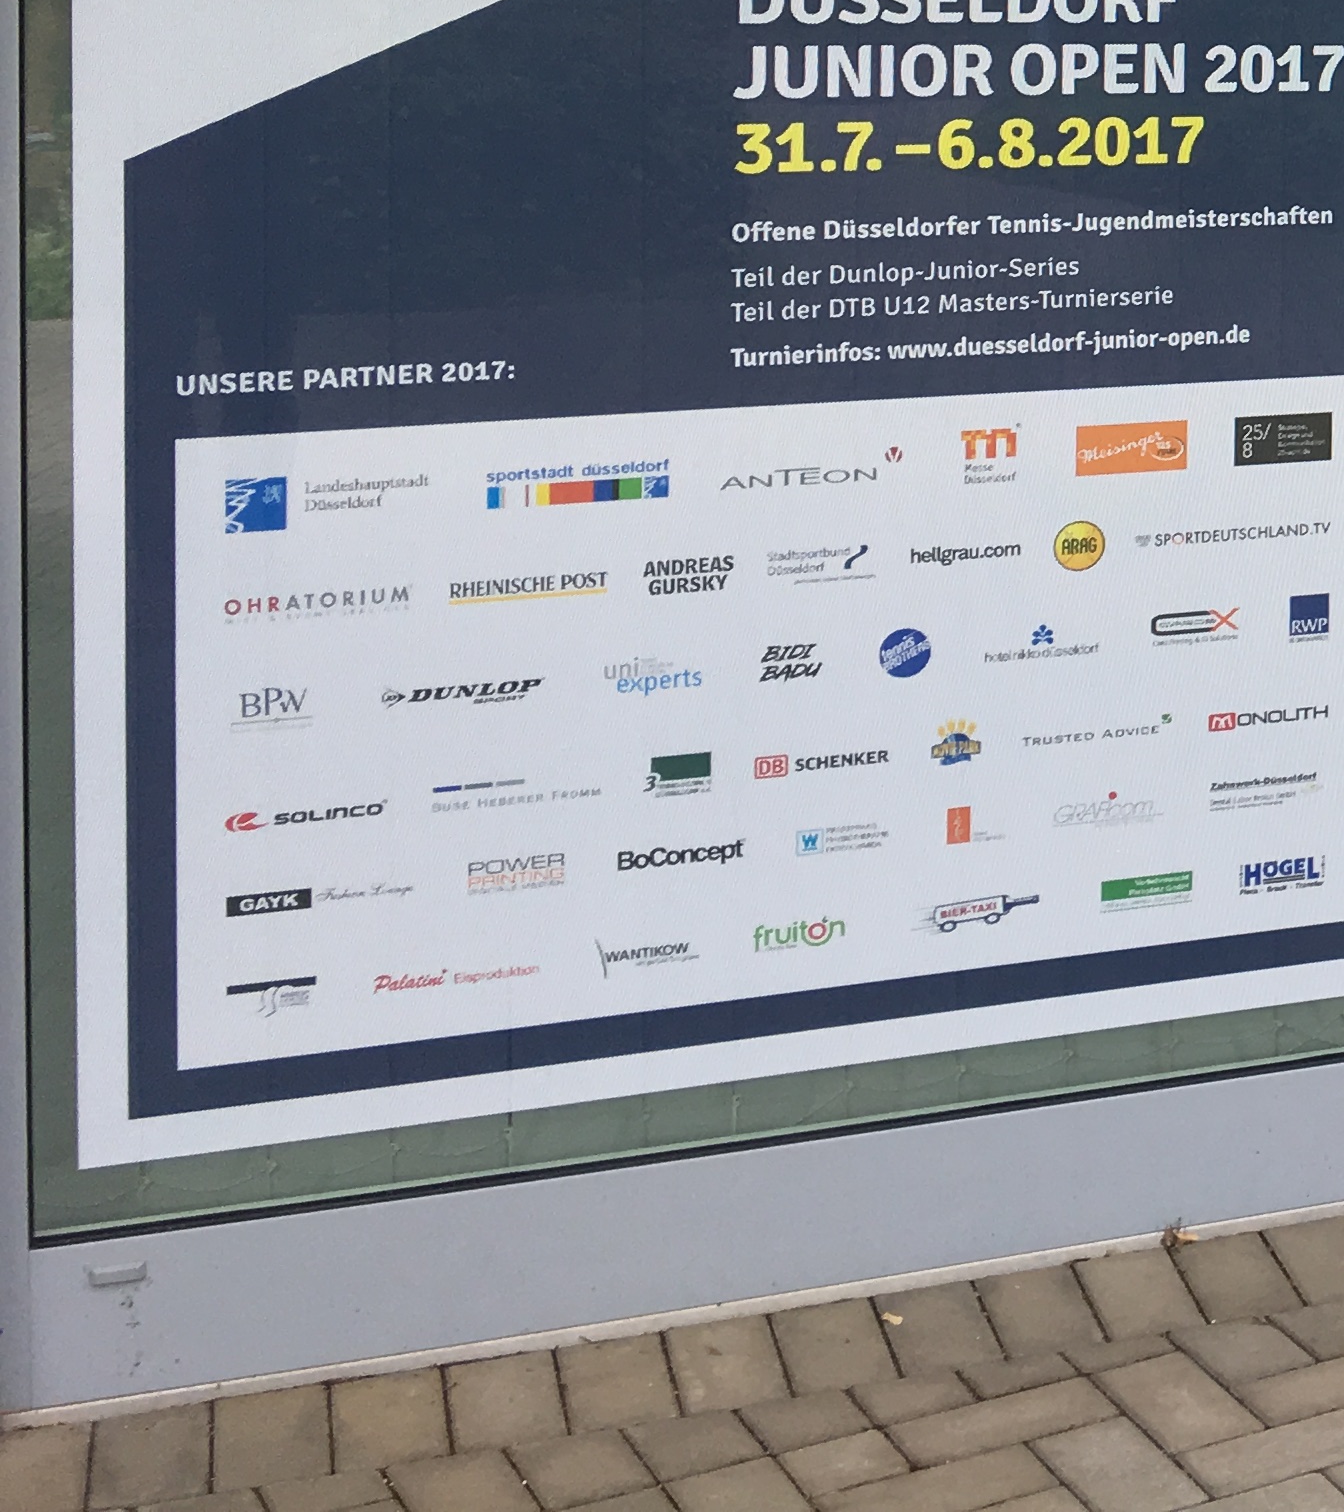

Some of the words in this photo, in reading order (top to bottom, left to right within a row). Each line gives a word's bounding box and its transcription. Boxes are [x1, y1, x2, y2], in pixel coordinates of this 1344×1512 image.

[733, 44, 994, 100] JUNIOR
[1010, 42, 1186, 96] OPEN
[731, 219, 816, 245] Offene
[823, 210, 981, 241] Düsseldorfer
[987, 204, 1334, 240] Tennis-Jugendmeisterschaften
[731, 265, 776, 289] Teil
[781, 263, 822, 287] der
[828, 257, 1080, 290] Dunlop-Junior-Series
[731, 299, 776, 324] Teil
[781, 297, 822, 322] der
[828, 295, 877, 320] DTB
[883, 293, 930, 318] U12
[938, 286, 1174, 315] Masters-Turnierserie
[730, 341, 881, 369] Turnierinfos:
[887, 325, 1251, 361] www.duesseldorf-junior-open.de
[176, 369, 294, 397] UNSERE
[303, 362, 434, 390] PARTNER
[441, 360, 516, 383] 2017:
[1241, 422, 1272, 441] 25/
[1077, 431, 1164, 465] Meisinger
[1242, 441, 1254, 459] 8
[486, 464, 574, 484] sportstadt
[581, 458, 670, 478] düsseldorf
[720, 467, 878, 491] ANTEON
[304, 474, 430, 495] Landeshauptstadt
[304, 493, 383, 513] Düsseldorf
[1061, 536, 1097, 556] ARAG
[1155, 522, 1331, 548] SPORTDEUTSCHLAND.TV
[910, 542, 1021, 566] hellgrau.com
[643, 555, 734, 579] ANDREAS
[449, 576, 556, 600] RHEINISCHE
[560, 571, 608, 590] POST
[648, 574, 728, 596] GURSKY
[223, 586, 410, 616] OHRATORIUM
[1291, 617, 1328, 634] RWP
[760, 643, 817, 663] BIDI
[616, 667, 703, 696] experts
[759, 661, 822, 683] BADU
[407, 677, 543, 703] DUNLOP
[240, 687, 307, 718] BPW
[1208, 705, 1329, 731] MONOLITH
[1022, 732, 1095, 747] TRUSTED
[757, 758, 785, 777] DB
[794, 750, 889, 772] SCHENKER
[468, 852, 565, 876] POWER
[617, 842, 744, 871] BoConcept
[468, 868, 565, 889] PRINTING
[239, 893, 299, 913] GAYK
[940, 901, 998, 920] BIER-TAXI
[605, 941, 691, 963] WANTIKOW
[373, 969, 447, 994] Palatini
